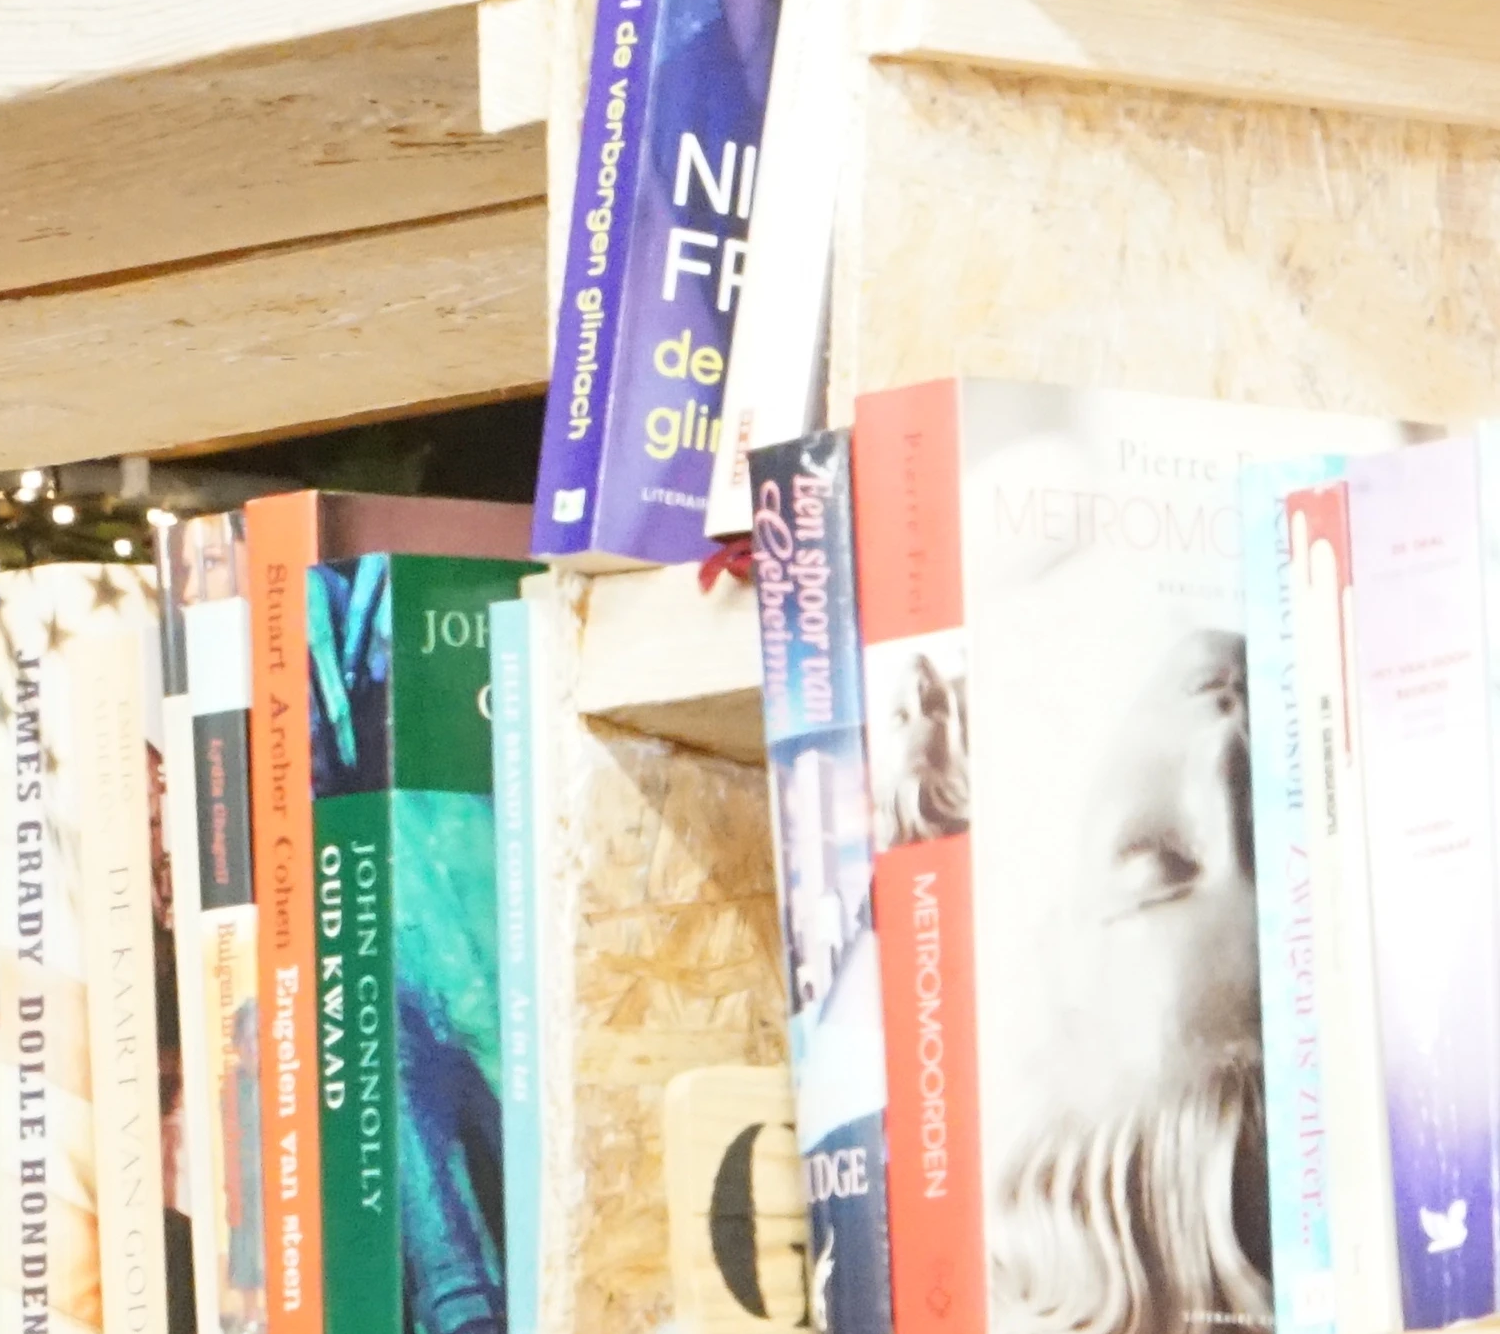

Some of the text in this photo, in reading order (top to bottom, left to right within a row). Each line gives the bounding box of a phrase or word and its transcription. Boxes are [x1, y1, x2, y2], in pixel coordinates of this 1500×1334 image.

[612, 21, 638, 69] de
[586, 78, 628, 277] verborgen
[567, 288, 602, 442] glimlach
[15, 649, 42, 803] JAMES
[17, 820, 43, 966] GRADY
[266, 562, 302, 1313] Stuart Archer Cohen Engelen van steen
[321, 844, 343, 1111] OUD KWAAD
[17, 995, 46, 1141] DOLLE
[351, 841, 384, 1214] JOHN CONNOLLY
[913, 872, 946, 1199] METROMOORDEN
